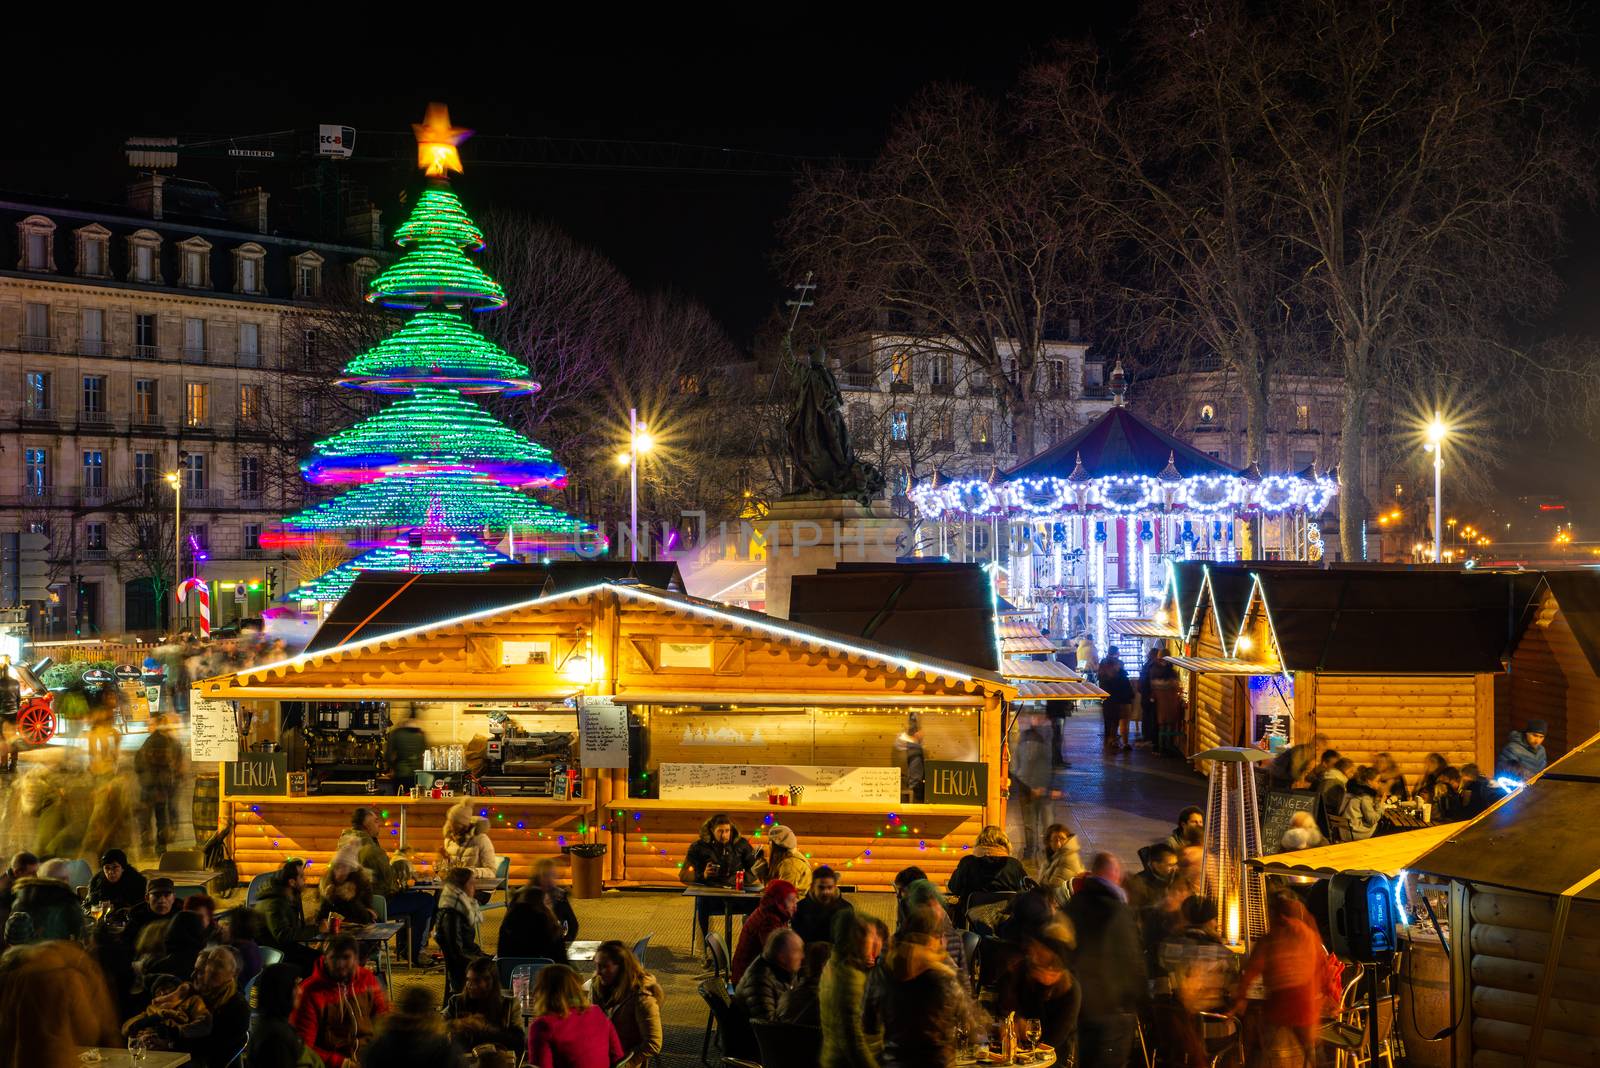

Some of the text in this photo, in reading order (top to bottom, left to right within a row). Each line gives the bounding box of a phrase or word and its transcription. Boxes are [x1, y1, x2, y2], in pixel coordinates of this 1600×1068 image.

[320, 136, 342, 144] EC-B
[233, 760, 278, 787] LEKUA
[933, 768, 978, 796] LEKUA
